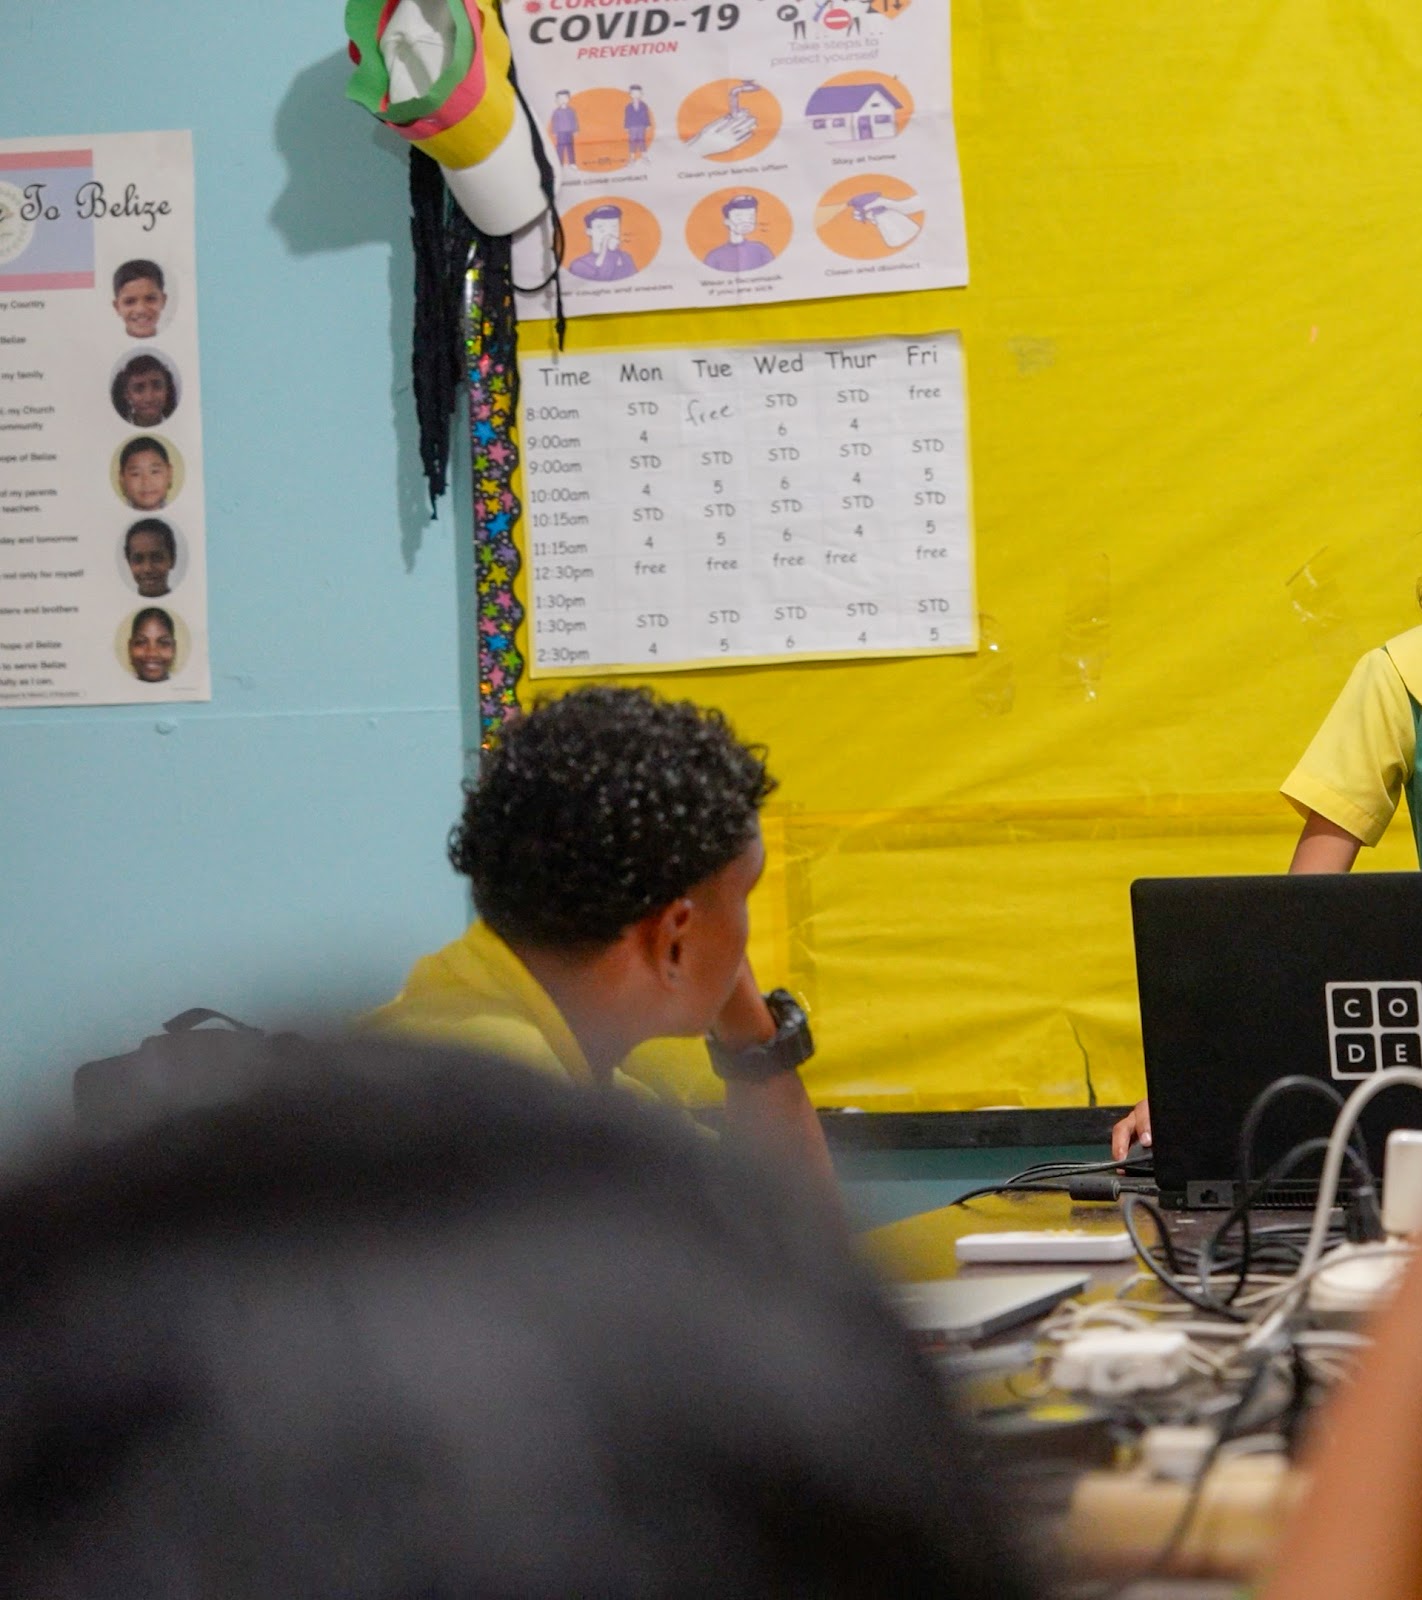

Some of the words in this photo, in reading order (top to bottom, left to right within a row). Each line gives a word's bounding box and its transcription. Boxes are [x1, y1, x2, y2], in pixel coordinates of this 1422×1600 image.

[529, 3, 740, 45] COVID-19
[576, 41, 678, 60] PREVENTION
[788, 41, 821, 52] Take
[823, 39, 862, 51] steps
[865, 37, 880, 48] to
[770, 53, 821, 67] protect
[824, 49, 880, 64] yourself
[831, 157, 854, 166] Stay
[868, 153, 897, 163] home
[677, 170, 706, 180] Clean
[707, 170, 728, 179] your
[20, 183, 60, 222] To
[76, 181, 172, 232] Belize
[855, 265, 876, 275] and
[11, 299, 46, 310] Country
[0, 335, 27, 345] Belize
[539, 367, 592, 388] Time
[619, 362, 664, 384] Mon
[692, 358, 734, 379] Tue
[753, 351, 805, 376] Wed
[824, 349, 878, 371] Thur
[906, 344, 939, 367] Fri
[1, 372, 14, 382] my
[17, 369, 44, 380] family
[765, 392, 799, 409] STD
[837, 388, 870, 404] STD
[908, 384, 942, 401] free
[7, 408, 20, 417] my
[23, 405, 55, 416] Church
[525, 405, 581, 422] 8:00am
[627, 401, 660, 417] STD
[684, 399, 735, 427] free
[527, 434, 582, 450] 9:00am
[639, 429, 649, 444] 4
[776, 422, 788, 437] 6
[849, 417, 860, 431] 4
[30, 452, 57, 462] Belize
[528, 460, 583, 475] 9:00am
[629, 454, 663, 470] STD
[701, 450, 734, 466] STD
[767, 446, 800, 462] STD
[839, 442, 873, 458] STD
[911, 437, 945, 454] STD
[530, 488, 591, 503] 10:00am
[642, 483, 652, 497] 4
[712, 479, 724, 495] 5
[779, 476, 791, 491] 6
[851, 471, 862, 485] 4
[923, 466, 935, 482] 5
[25, 489, 58, 499] parents
[533, 512, 590, 529] 10:15am
[631, 506, 665, 523] STD
[703, 502, 737, 518] STD
[770, 498, 804, 515] STD
[841, 494, 875, 510] STD
[913, 490, 947, 506] STD
[533, 541, 589, 557] 11:15am
[643, 535, 654, 549] 4
[715, 531, 727, 547] 5
[782, 527, 793, 543] 6
[853, 523, 864, 538] 4
[925, 519, 937, 535] 5
[534, 565, 595, 583] 12:30pm
[633, 559, 668, 576] free
[705, 556, 739, 572] free
[772, 552, 806, 568] free
[825, 549, 859, 566] free
[915, 544, 949, 561] free
[55, 568, 84, 579] myself
[42, 604, 79, 615] brothers
[535, 594, 587, 612] 1:30pm
[536, 618, 587, 636] 1:30pm
[635, 612, 670, 629] STD
[708, 609, 741, 625] STD
[773, 605, 808, 621] STD
[846, 601, 880, 618] STD
[917, 597, 951, 614] STD
[36, 639, 62, 649] Belize
[537, 647, 591, 665] 2:30pm
[648, 642, 659, 656] 4
[719, 637, 731, 653] 5
[785, 635, 796, 650] 6
[857, 631, 868, 645] 4
[929, 626, 941, 642] 5
[40, 660, 67, 670] Belize
